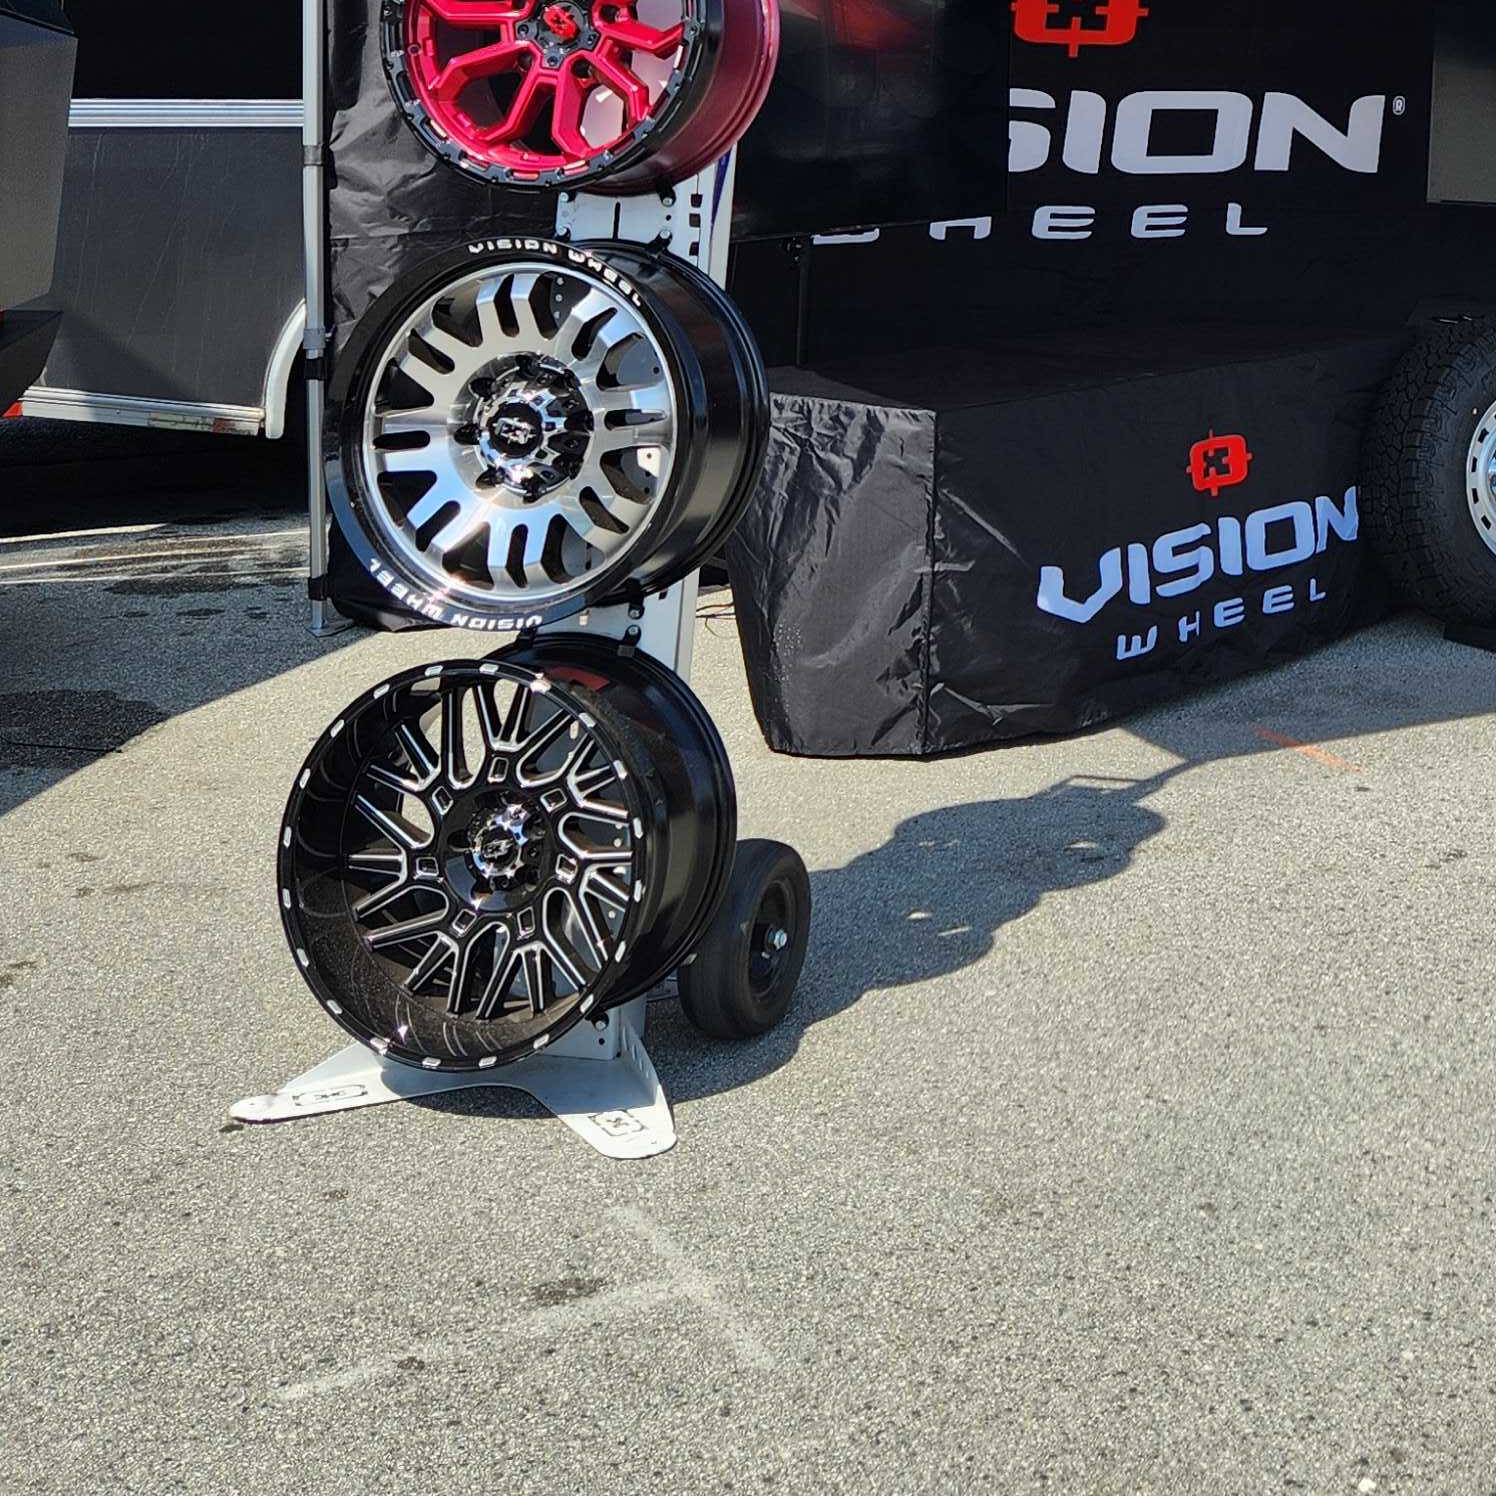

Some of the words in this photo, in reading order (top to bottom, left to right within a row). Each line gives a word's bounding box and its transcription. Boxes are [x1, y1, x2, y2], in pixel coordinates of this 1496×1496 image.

[1009, 88, 1386, 174] ION
[468, 238, 557, 255] VISION
[568, 249, 642, 308] WHEEL
[369, 558, 446, 621] WHEEL
[1036, 485, 1360, 624] VISION
[452, 613, 543, 630] VISION
[1115, 578, 1327, 661] WHEEL
